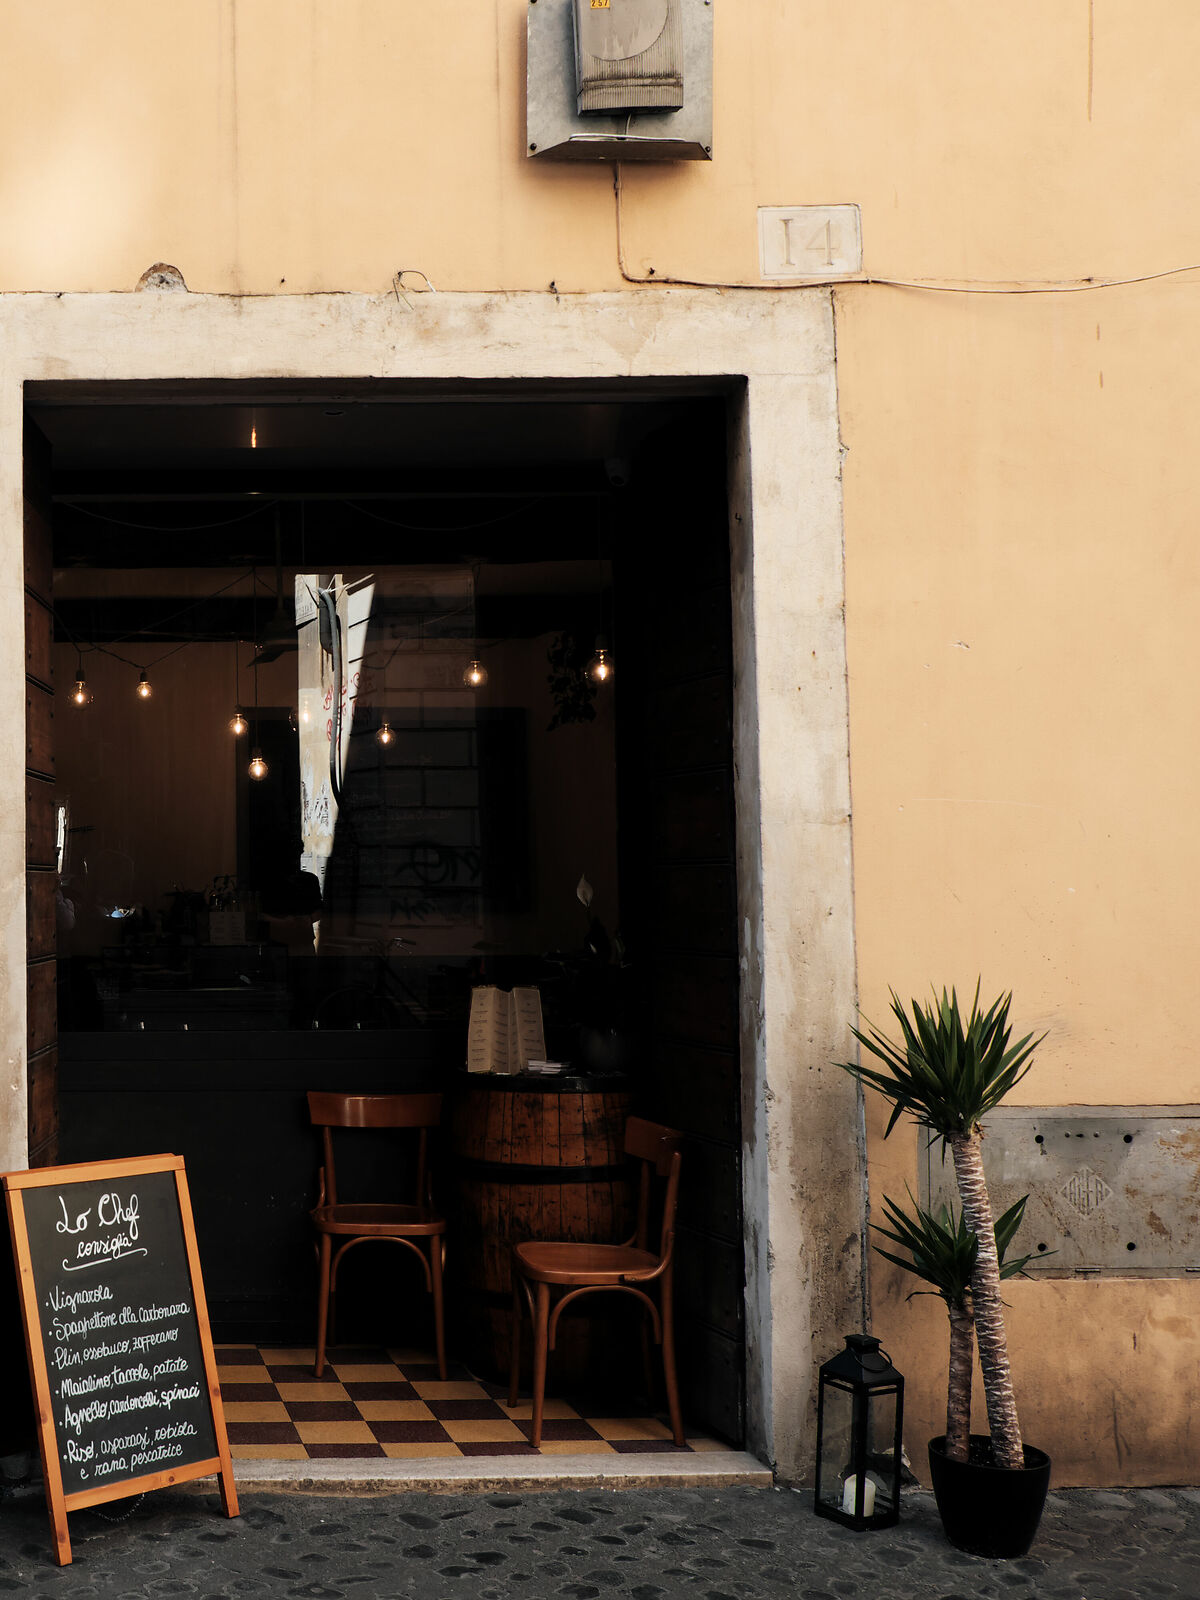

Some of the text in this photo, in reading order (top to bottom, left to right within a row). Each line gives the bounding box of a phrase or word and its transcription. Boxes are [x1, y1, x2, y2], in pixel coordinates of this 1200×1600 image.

[778, 218, 837, 266] 14
[56, 1193, 141, 1241] Lo Chef
[76, 1233, 133, 1259] consiglia
[49, 1285, 114, 1314] Vignarola
[52, 1311, 118, 1342] Spaghettone
[54, 1346, 84, 1370] Plin,
[83, 1340, 132, 1361] ossobuco,
[61, 1374, 113, 1399] Maialino,
[153, 1356, 189, 1381] patate
[64, 1400, 111, 1435] Agnello,
[160, 1382, 201, 1410] spinaci
[66, 1421, 198, 1464] Riso, asparagi, robiola
[80, 1443, 183, 1480] e rana pescatrice
